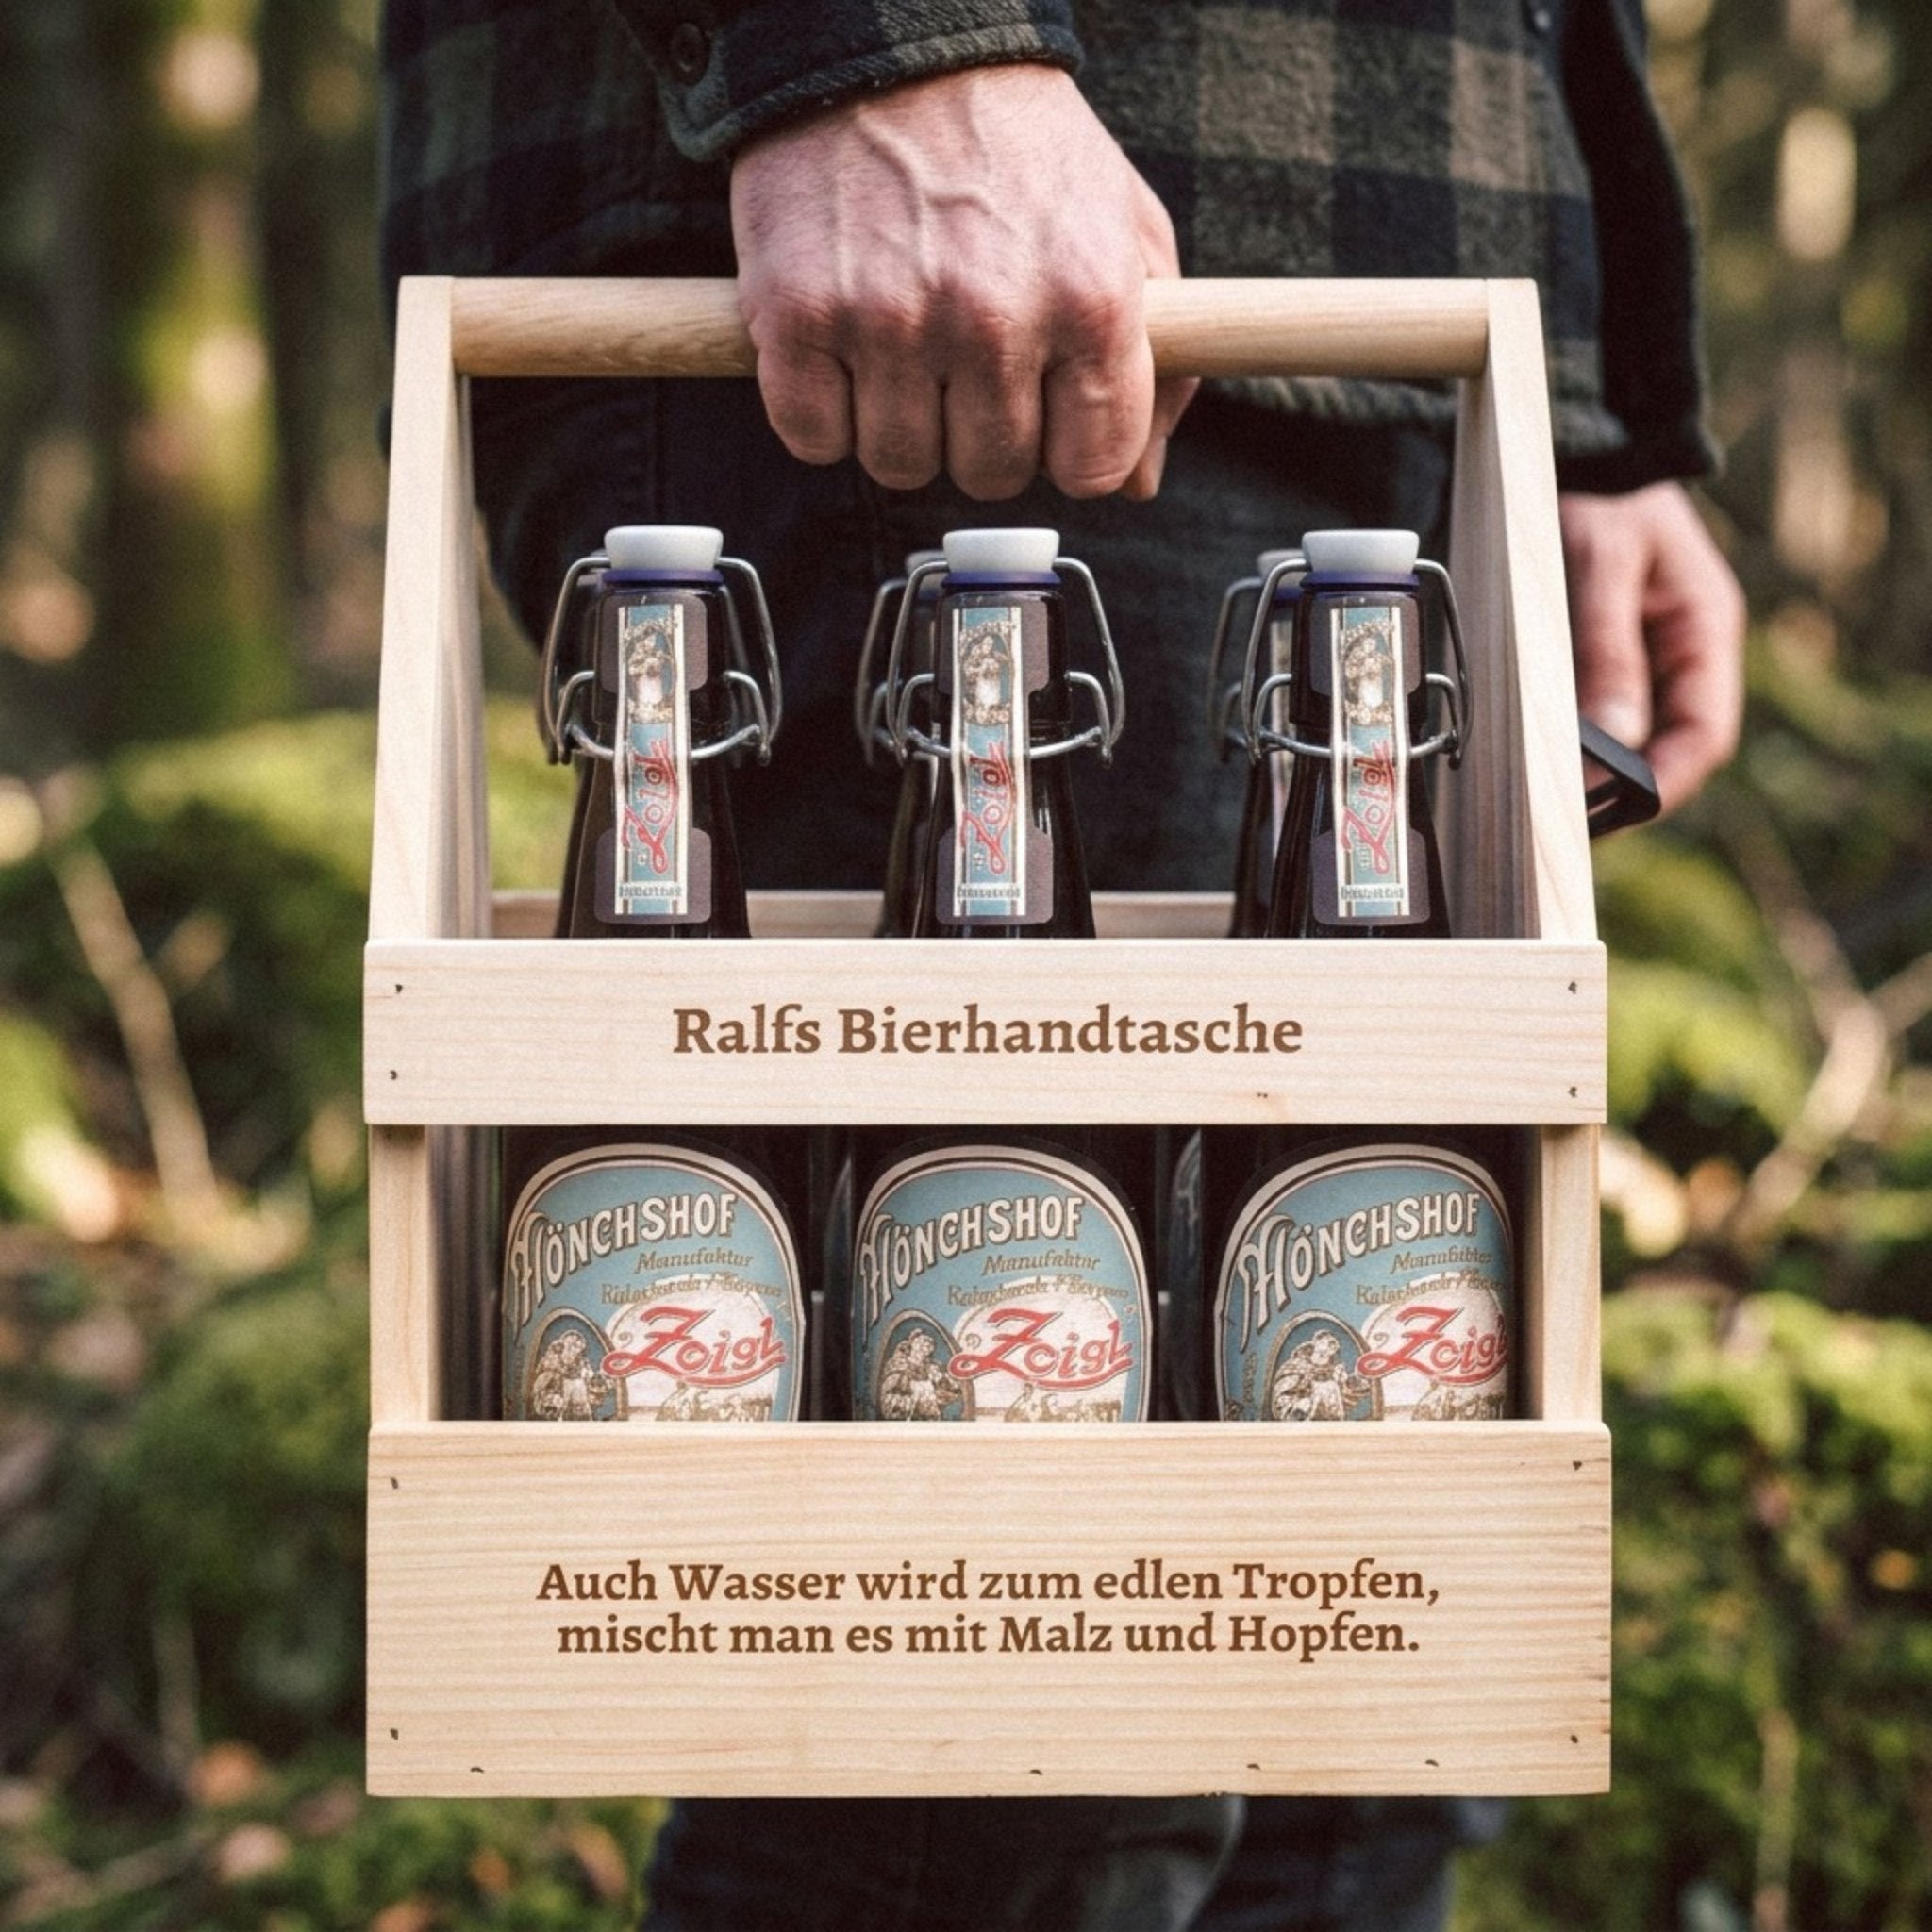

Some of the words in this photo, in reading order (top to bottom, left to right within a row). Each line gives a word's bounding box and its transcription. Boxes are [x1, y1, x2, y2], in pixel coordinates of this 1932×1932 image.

[674, 1003, 820, 1054] Ralfs
[838, 1003, 1303, 1054] Bierhandtasche
[600, 1306, 788, 1389] Zoigl
[947, 1307, 1134, 1391] Zoigl
[536, 1559, 658, 1601] Auch
[669, 1563, 846, 1601] Wasser
[856, 1559, 969, 1601] wird
[979, 1573, 1083, 1600] zum
[1093, 1558, 1224, 1600] edlen
[1232, 1558, 1440, 1610] Tropfen,
[558, 1612, 718, 1653] mischt
[729, 1625, 835, 1653] man
[845, 1625, 893, 1653] es
[906, 1613, 987, 1653] mit
[998, 1611, 1113, 1653] Malz
[1124, 1611, 1217, 1653] und
[1228, 1611, 1420, 1664] Hopfen.
